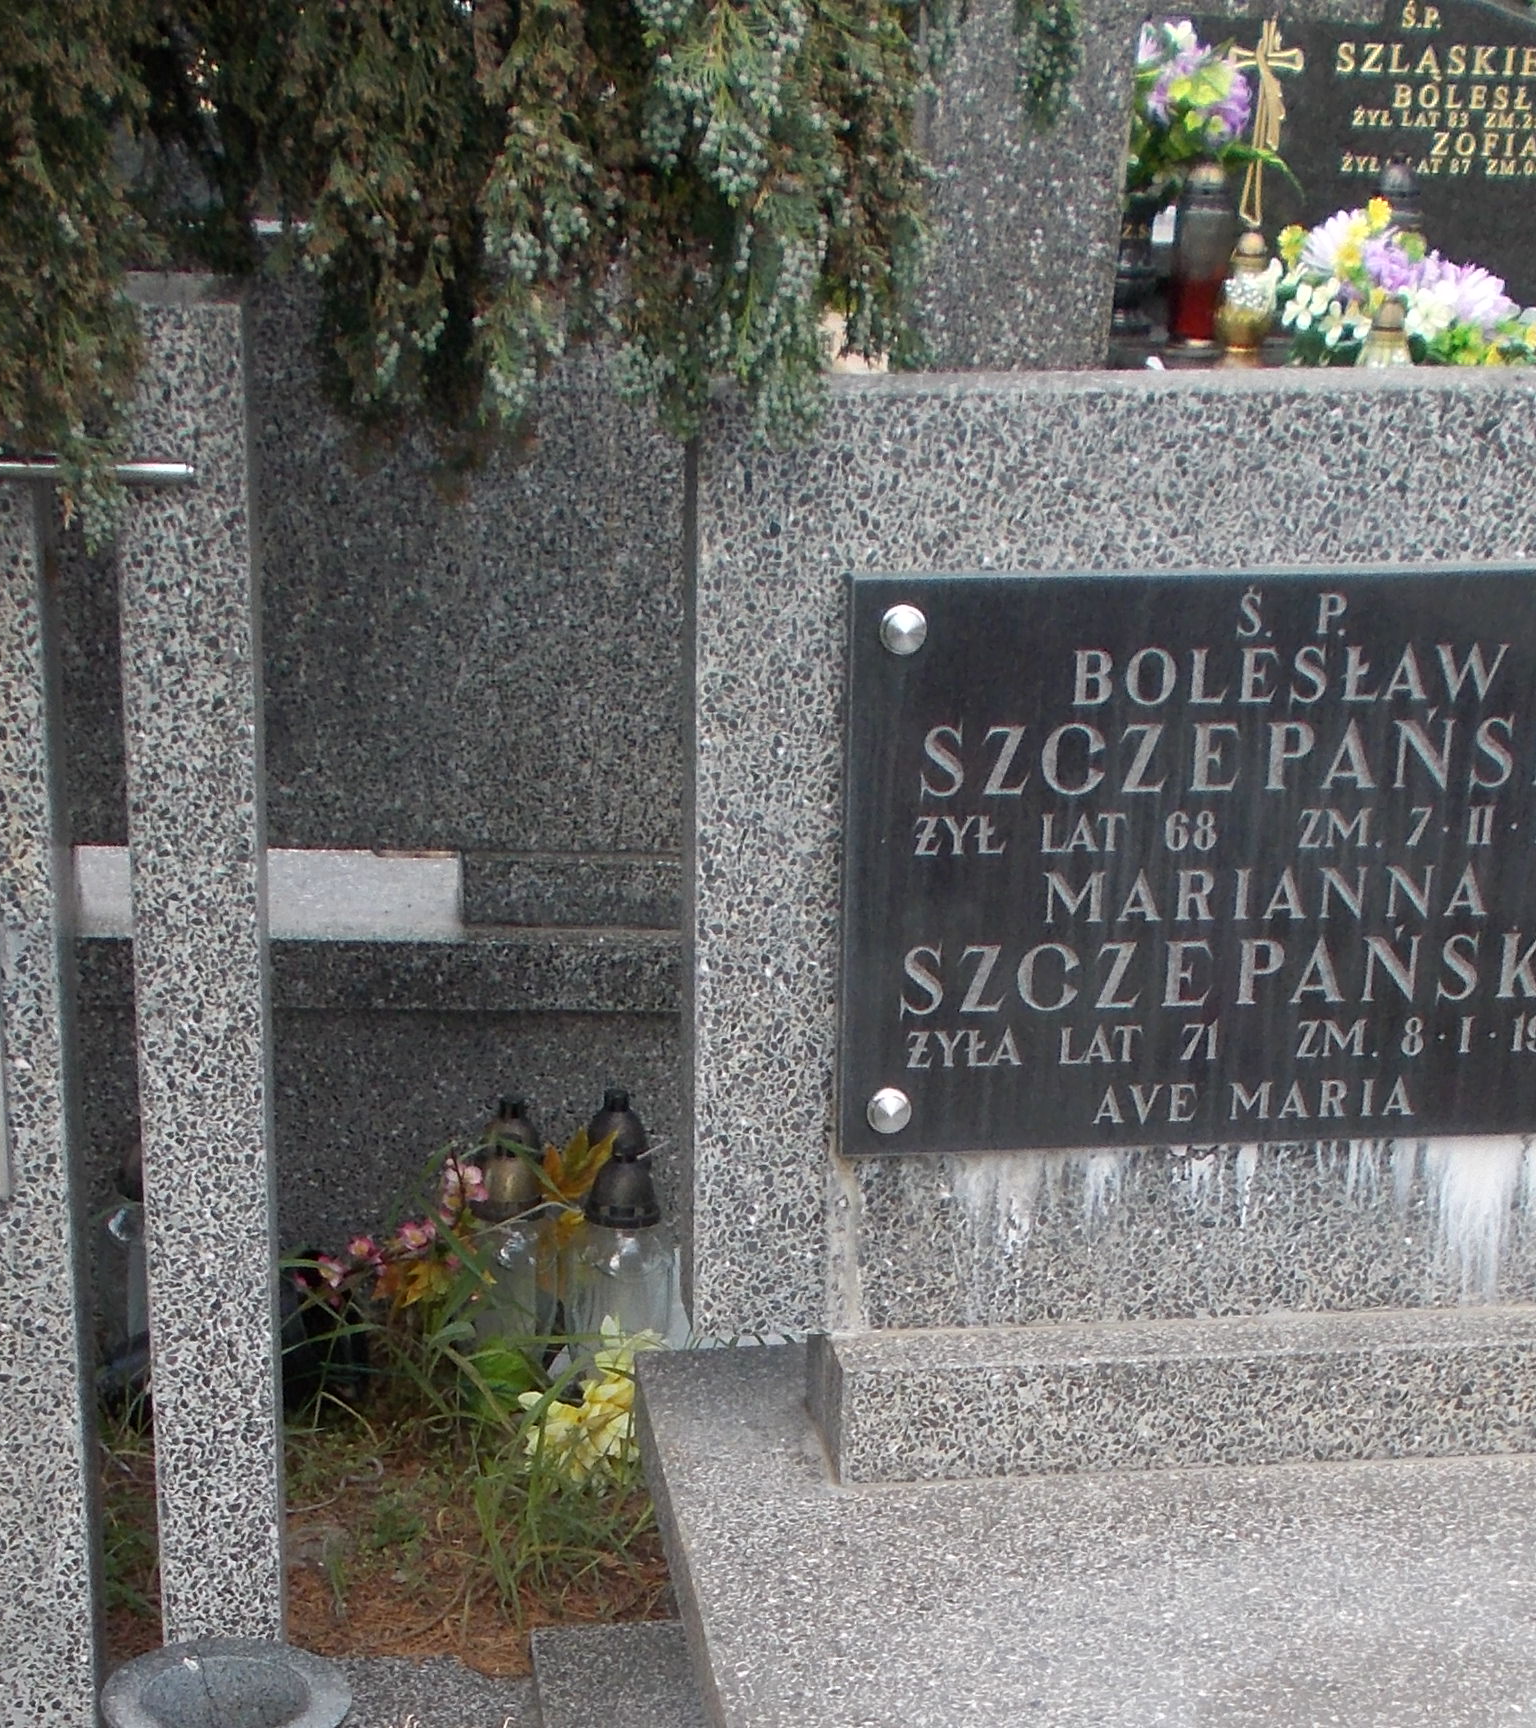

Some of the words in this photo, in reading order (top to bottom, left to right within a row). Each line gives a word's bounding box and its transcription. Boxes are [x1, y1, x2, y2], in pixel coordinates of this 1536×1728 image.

[1401, 111, 1441, 129] LAT
[1447, 112, 1470, 129] 83
[1448, 157, 1471, 174] 87
[1073, 642, 1512, 708] BOLESŁAW
[1041, 812, 1128, 854] LAT
[1165, 810, 1218, 852] 68
[1298, 806, 1383, 849] ZM.
[1043, 862, 1488, 924] MARIANNA
[1058, 1022, 1143, 1065] LAT
[1180, 1018, 1219, 1061] 71
[1295, 1018, 1380, 1059] ZM.
[1092, 1081, 1200, 1126] AVE
[1228, 1074, 1415, 1122] MARIA
